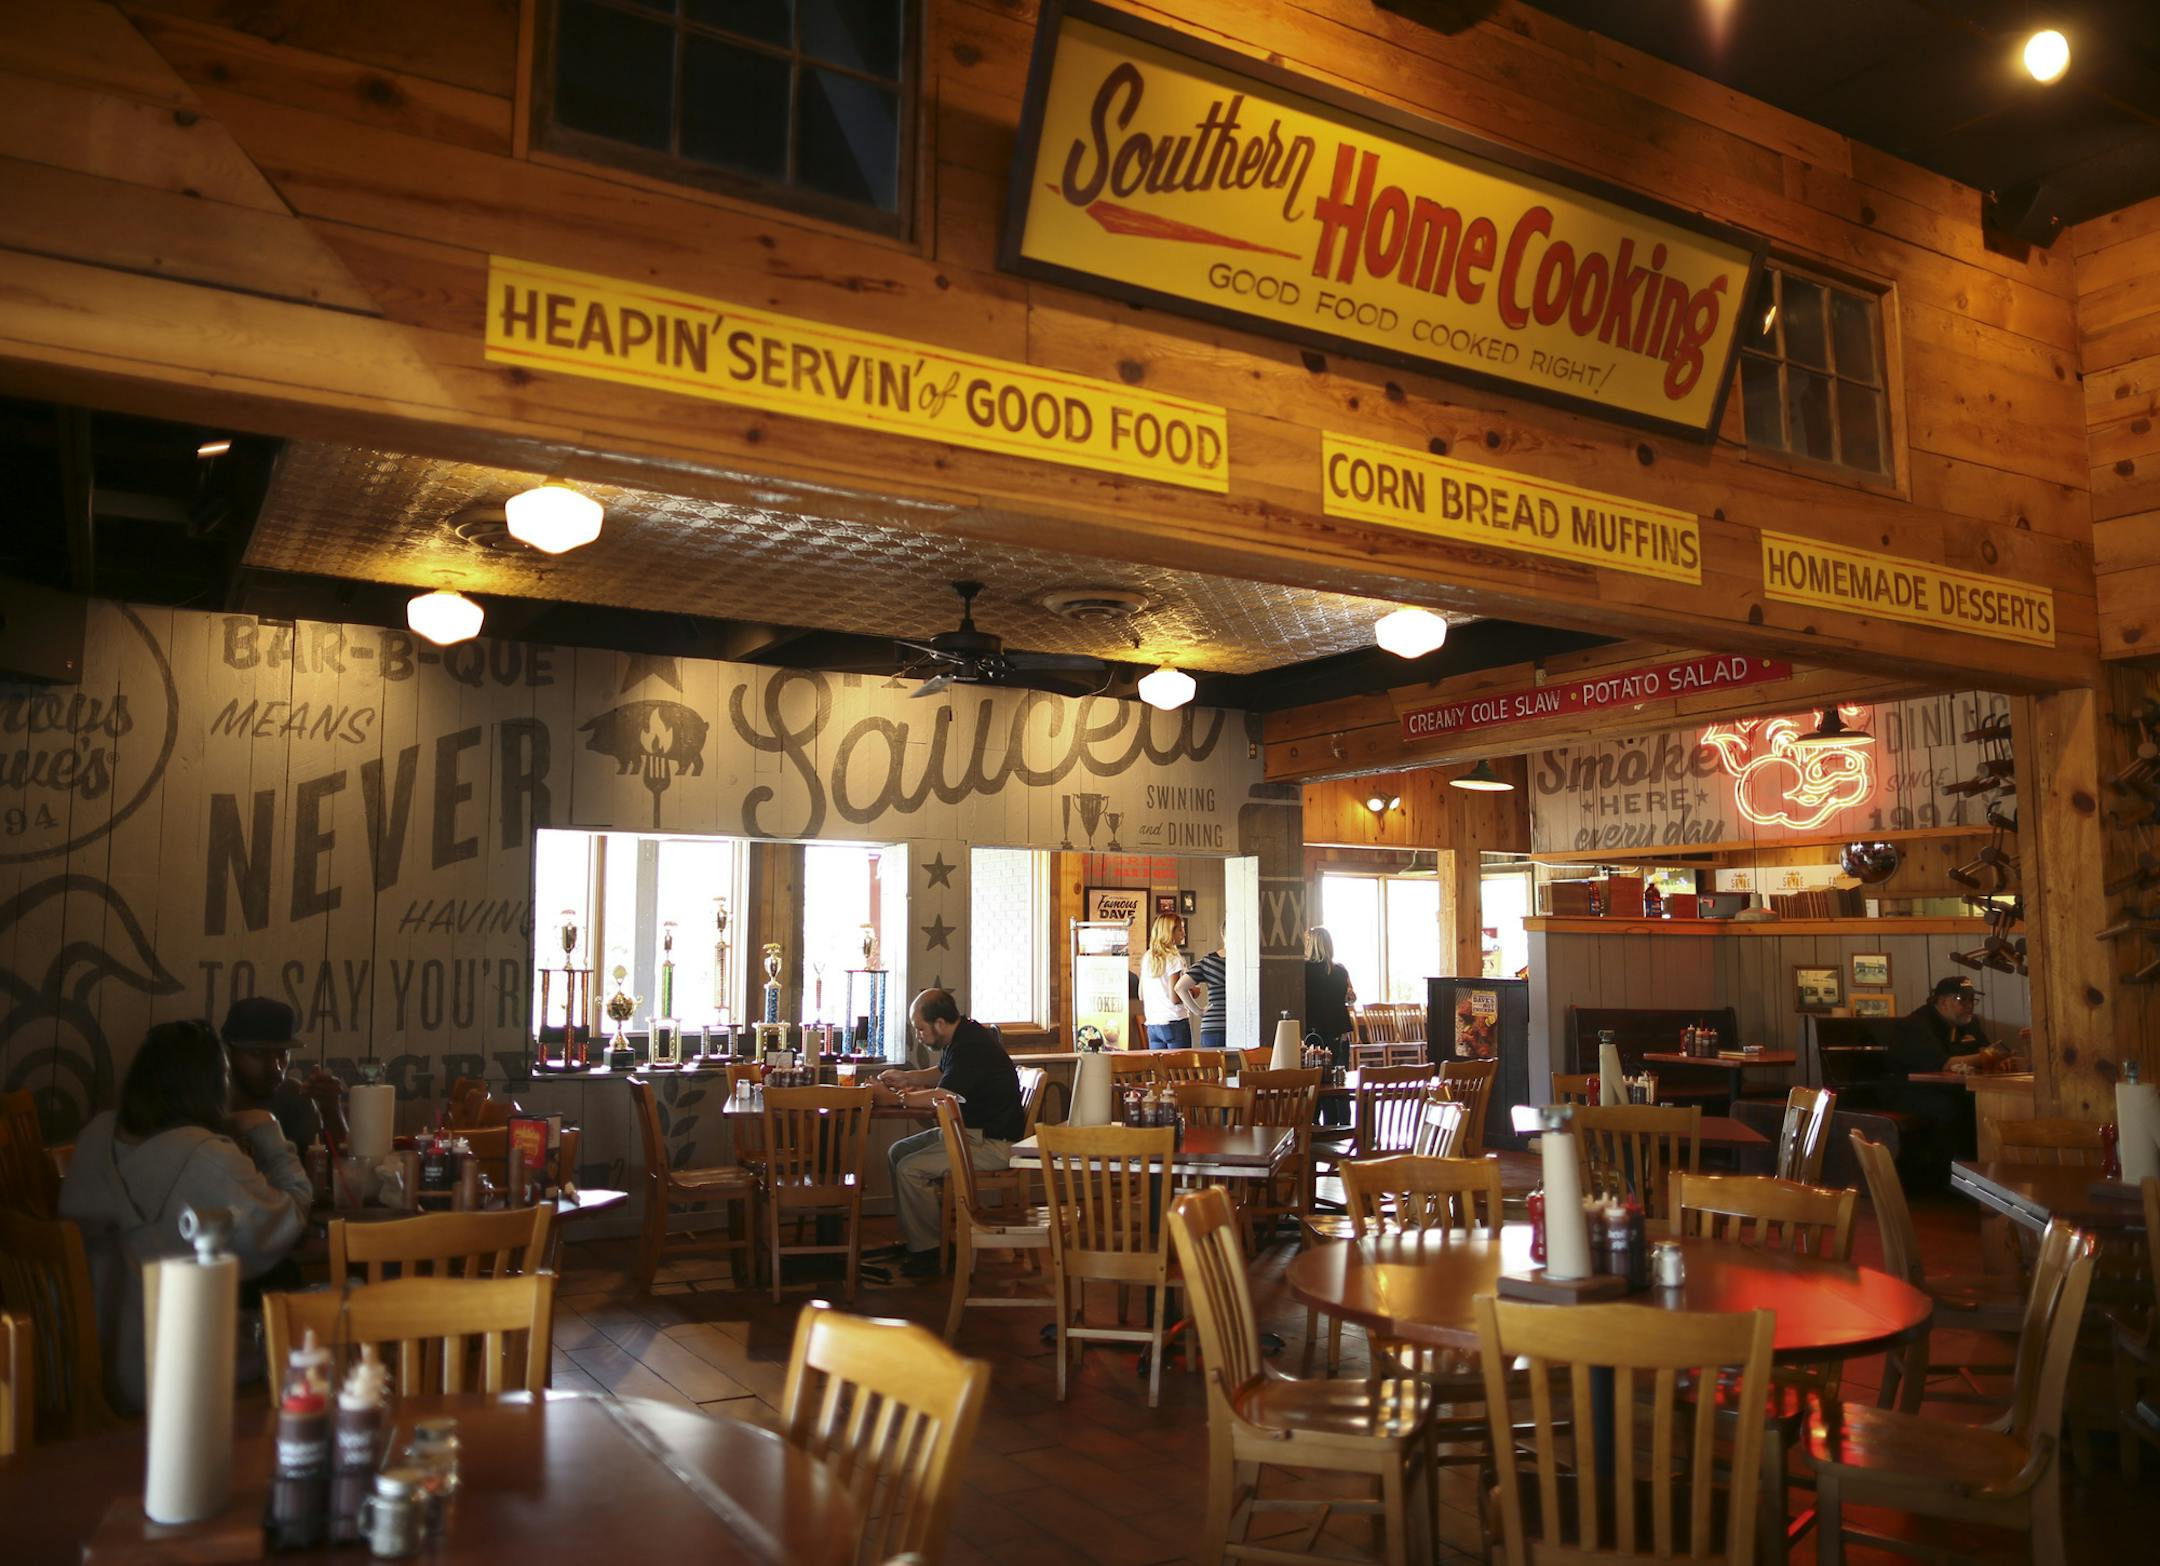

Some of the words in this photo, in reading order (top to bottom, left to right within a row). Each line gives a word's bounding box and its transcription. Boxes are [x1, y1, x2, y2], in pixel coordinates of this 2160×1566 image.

[1062, 62, 1313, 222] Southern
[1312, 143, 1497, 304] Home
[1499, 206, 1728, 399] Cooking
[1208, 262, 1300, 307] GOOD
[1314, 291, 1398, 332] FOOD
[1412, 319, 1519, 364] COOKED
[1530, 349, 1616, 394] RIGHT!
[503, 283, 722, 373] HEAPIN'
[728, 331, 921, 411] SERVIN'
[919, 372, 957, 418] of
[966, 378, 1093, 443] GOOD
[1111, 409, 1222, 470] FOOD
[1329, 453, 1425, 515] CORN
[1441, 477, 1560, 540] BREAD
[1571, 508, 1698, 569] MUFFINS
[1768, 547, 1929, 610] HOMEMADE
[1940, 580, 2051, 634] DESSERTS
[222, 614, 556, 688] BAR-B-QUE
[210, 698, 376, 743] MEANS
[1409, 707, 1466, 733] CREAMY
[1471, 699, 1508, 723] COLE
[1514, 690, 1561, 716] SLAW
[1584, 673, 1660, 705] POTATO
[1668, 657, 1748, 690] SALAD
[1146, 784, 1216, 812] SWINING
[1537, 734, 1722, 795] Smoke
[1885, 768, 1949, 792] SINCE
[204, 716, 552, 937] NEVER
[1139, 822, 1163, 835] and
[1168, 822, 1223, 848] DINING
[1574, 822, 1655, 850] every
[1662, 802, 1726, 845] day
[1600, 788, 1690, 816] HERE
[1868, 800, 1968, 831] 1994
[1097, 894, 1139, 911] Famous
[282, 958, 369, 1032] SAY
